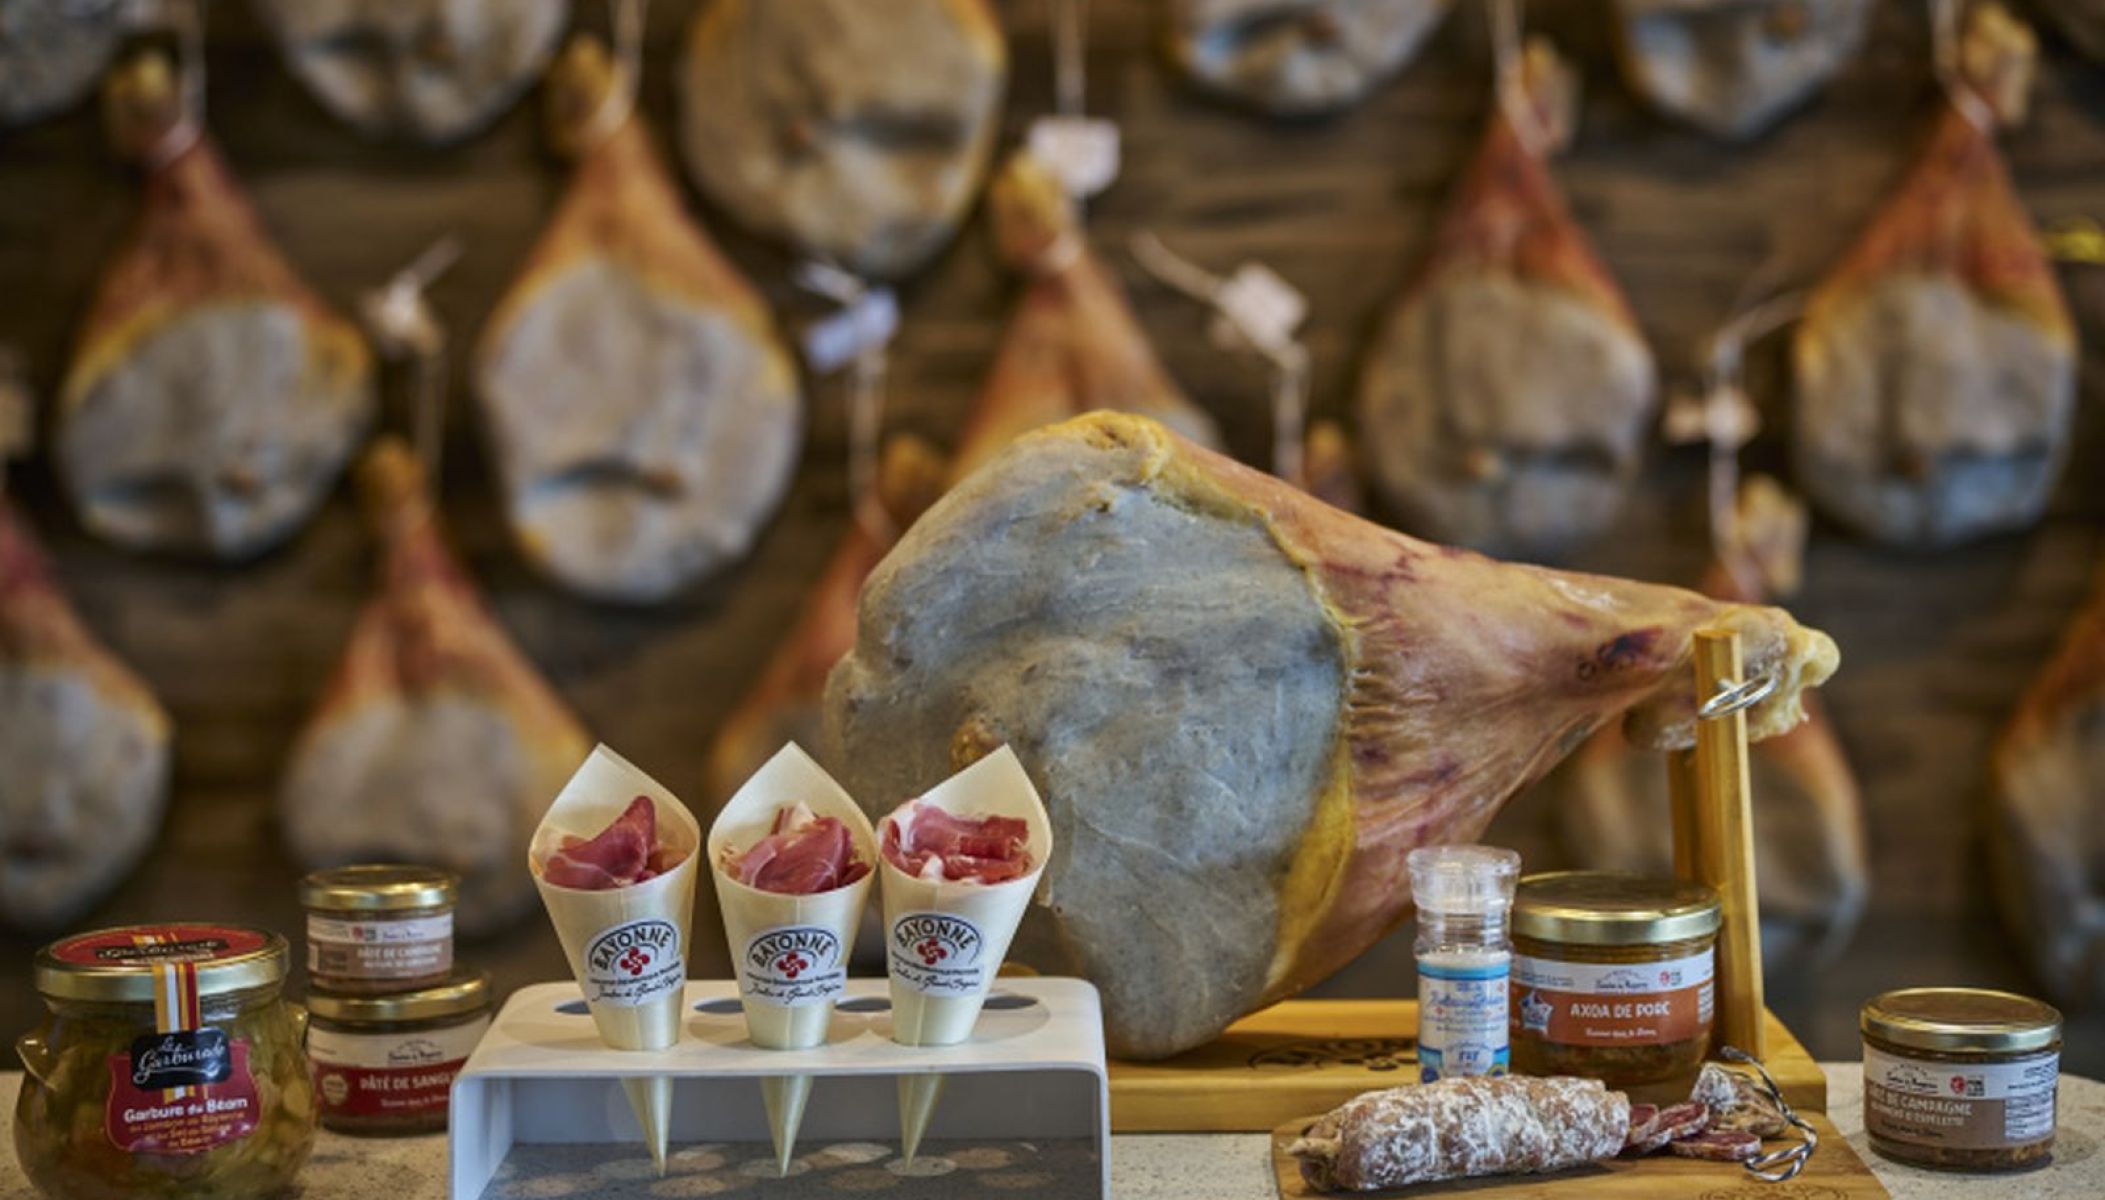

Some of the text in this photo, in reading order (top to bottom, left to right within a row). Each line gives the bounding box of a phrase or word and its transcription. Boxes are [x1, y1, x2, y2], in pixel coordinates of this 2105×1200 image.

[897, 919, 977, 948] BAYONNE
[594, 927, 671, 970] BAYONNE
[752, 932, 832, 968] BAYONNE
[1570, 1001, 1670, 1018] AXOA DE PORC
[360, 1073, 389, 1091] PÂTÉ
[393, 1075, 410, 1090] DE
[124, 1098, 248, 1123] Garbure du Béarn
[1901, 1095, 1973, 1117] CAMPAGNE
